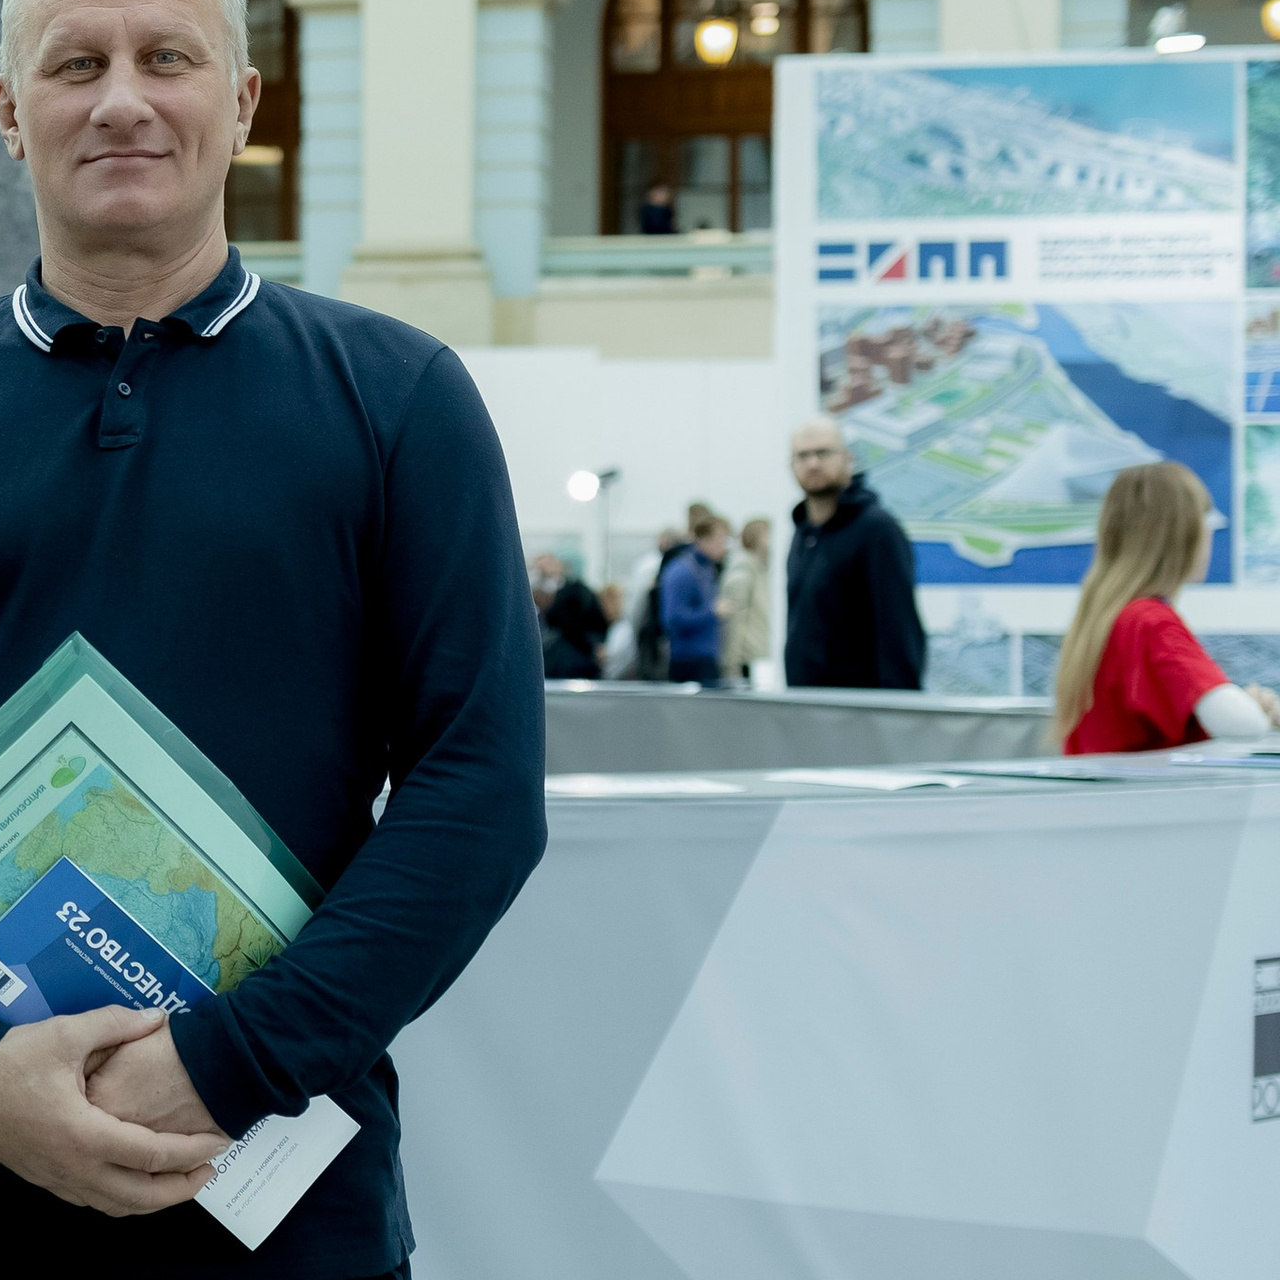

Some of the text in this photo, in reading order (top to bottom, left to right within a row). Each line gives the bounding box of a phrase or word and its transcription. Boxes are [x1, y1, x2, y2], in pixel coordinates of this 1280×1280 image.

[56, 901, 191, 1015] ДЧЕСТВО'23
[65, 937, 93, 965] ФЕСТИВАЛЬ
[226, 1202, 233, 1210] 31
[231, 1178, 254, 1204] ОКТЯБРЯ
[259, 1148, 278, 1172] НОЯБРЯ
[277, 1135, 290, 1149] 2023
